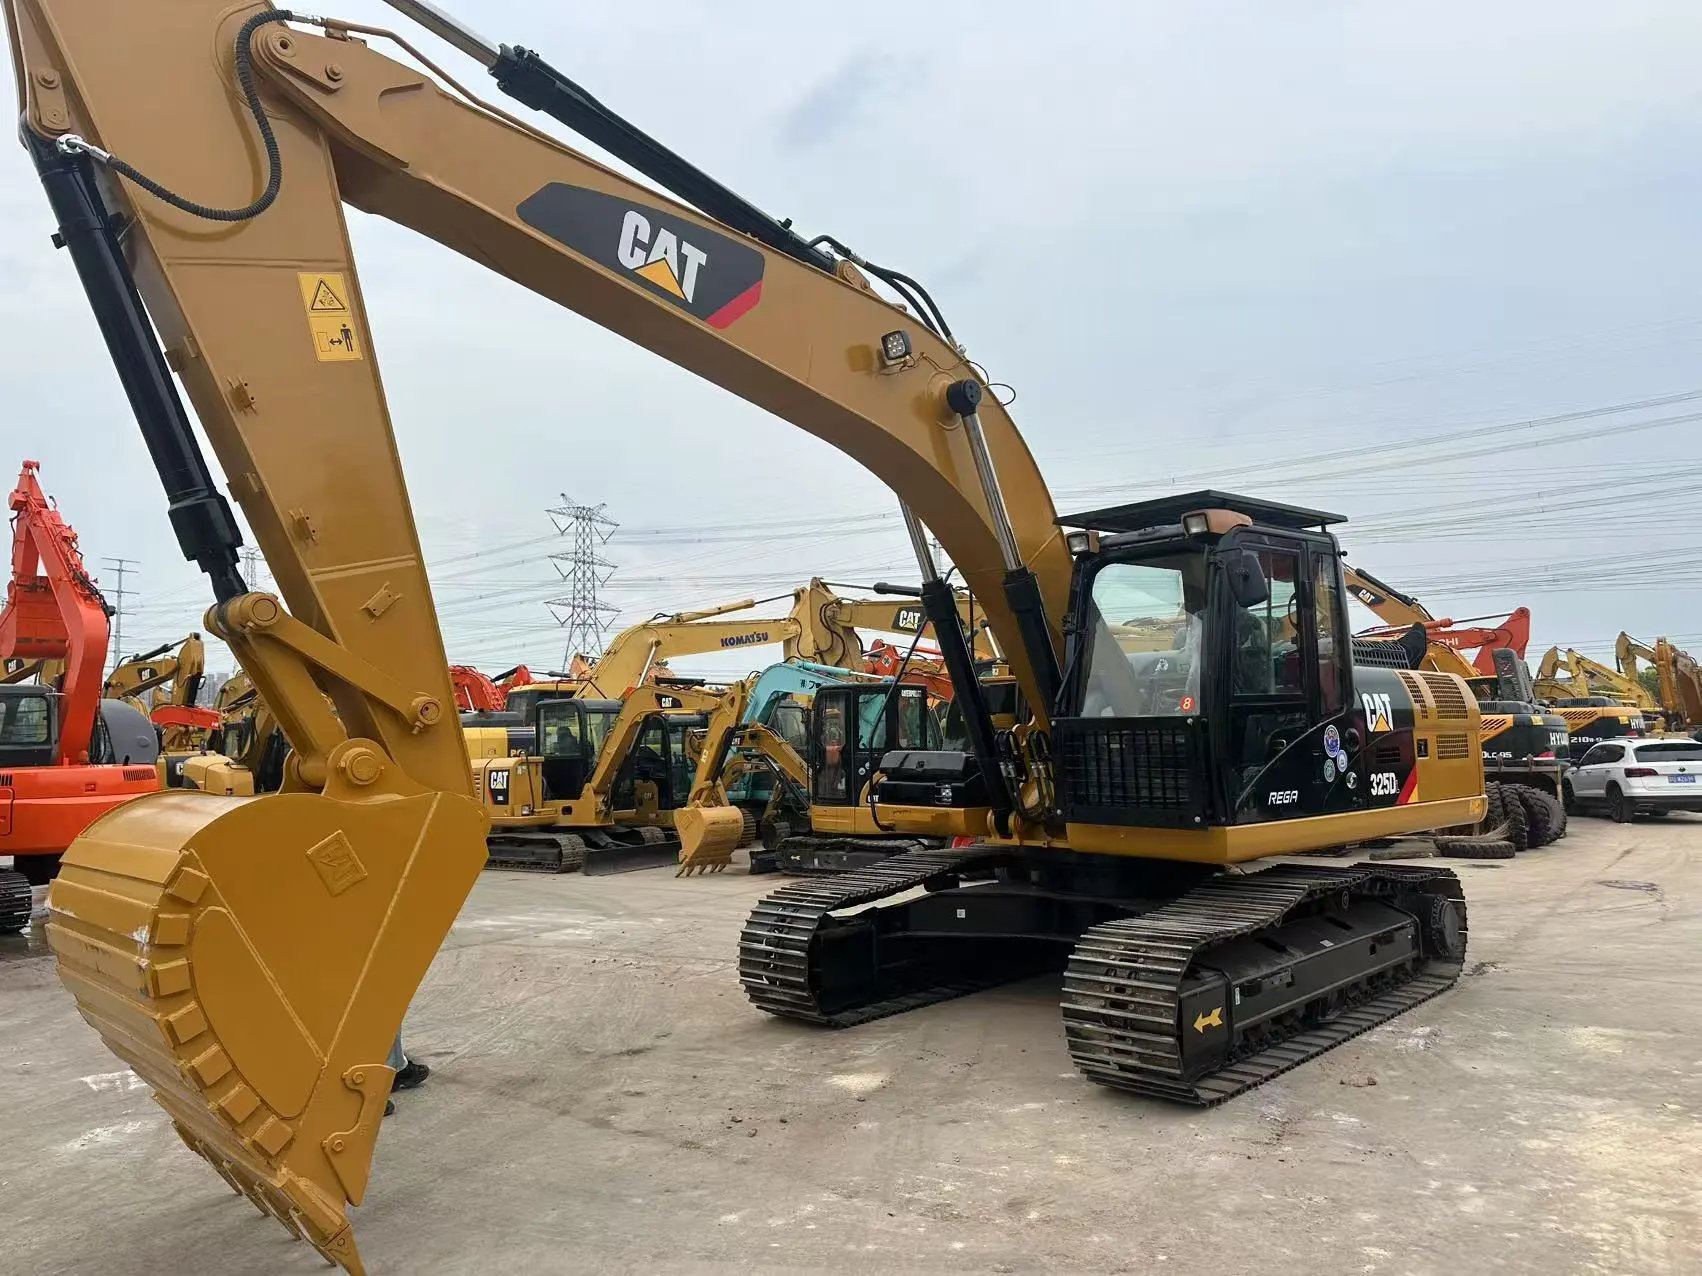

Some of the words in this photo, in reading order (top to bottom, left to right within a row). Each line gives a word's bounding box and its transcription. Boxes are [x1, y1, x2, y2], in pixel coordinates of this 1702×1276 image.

[618, 211, 707, 303] CAT
[1359, 589, 1375, 604] CAT
[899, 610, 920, 629] CAT
[721, 631, 768, 647] KOMATSU
[662, 697, 672, 707] CAT
[1183, 697, 1191, 710] 8
[1362, 693, 1393, 733] CAT
[490, 772, 508, 789] CAT
[1268, 790, 1298, 805] REGA
